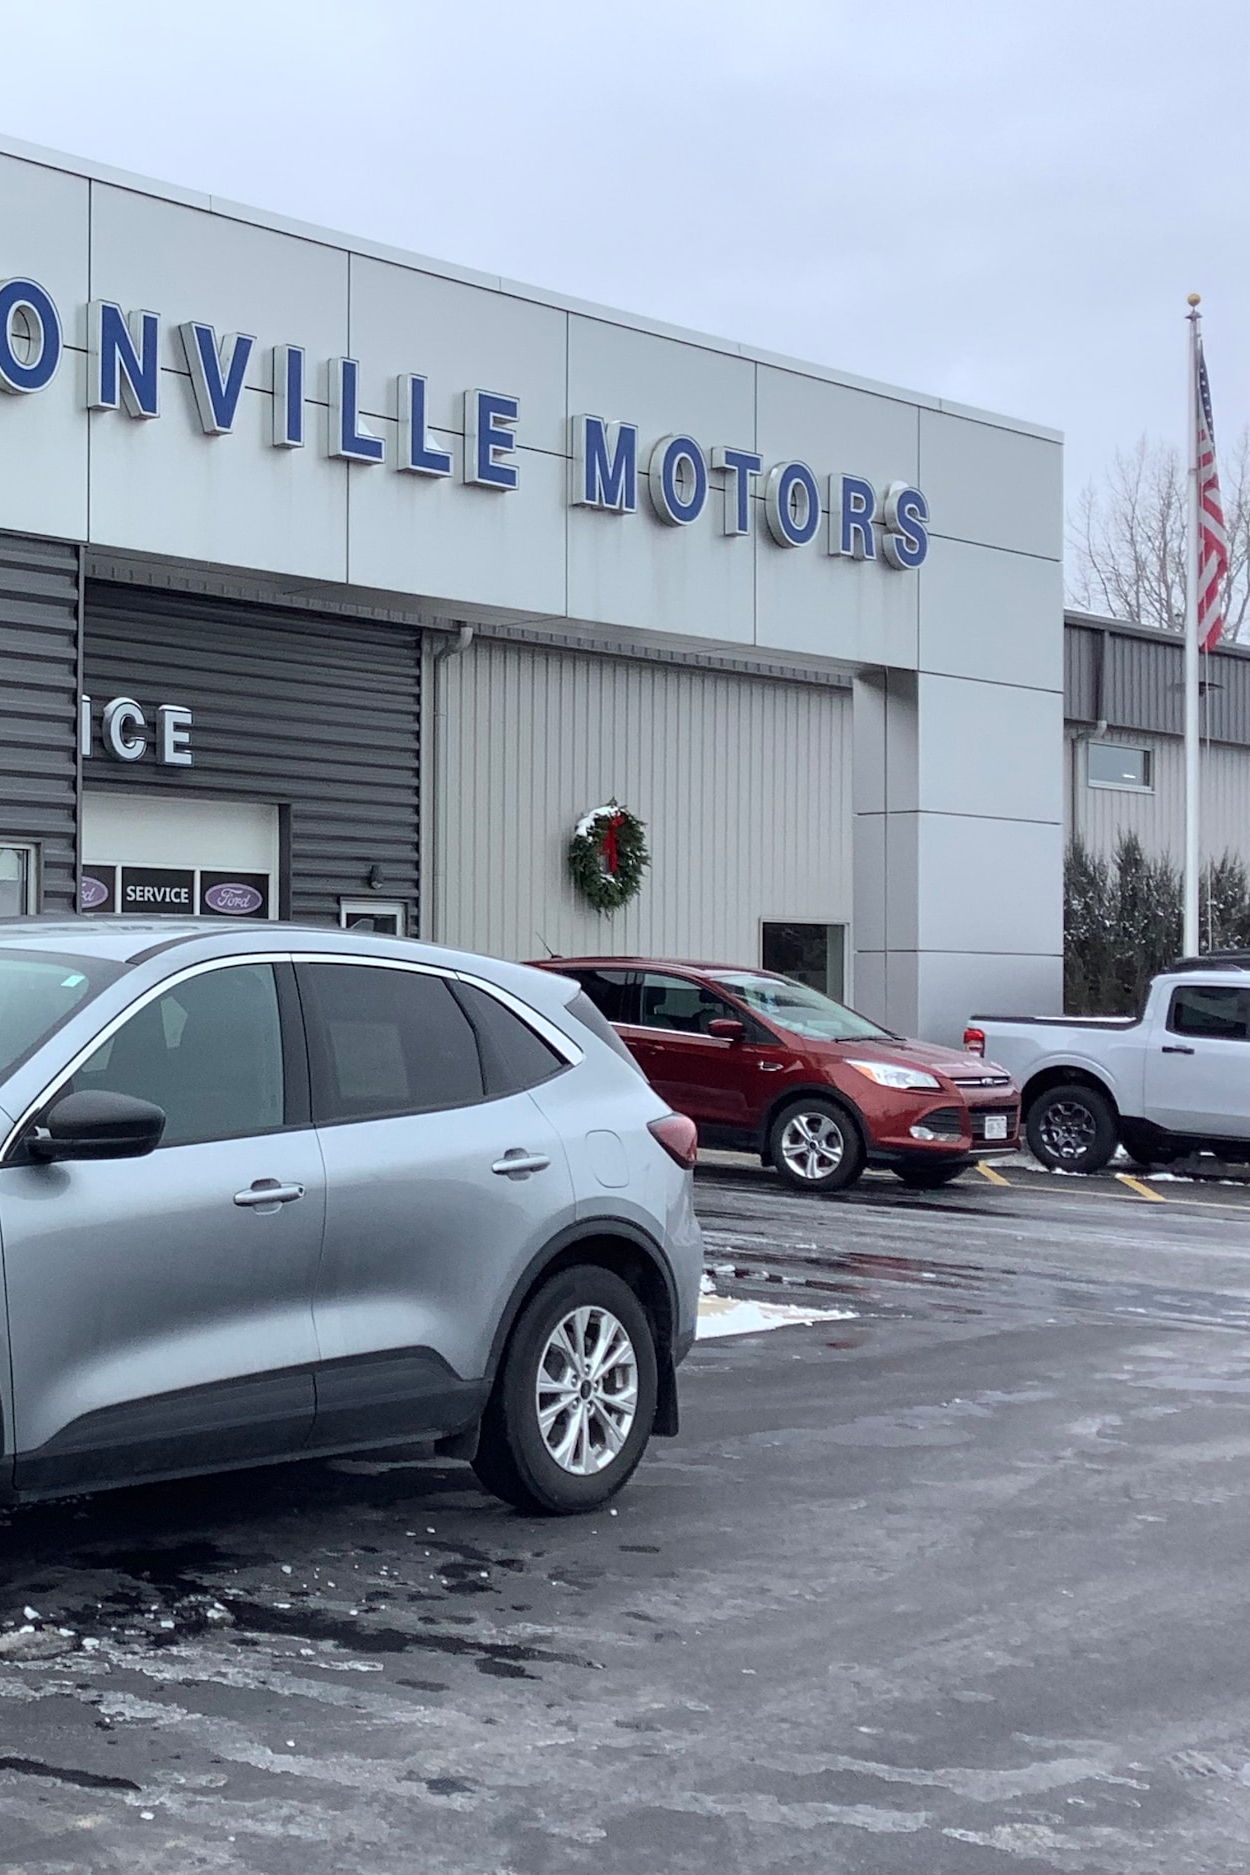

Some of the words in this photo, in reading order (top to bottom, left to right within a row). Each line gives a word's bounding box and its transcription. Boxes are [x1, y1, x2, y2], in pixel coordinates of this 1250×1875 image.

[571, 413, 932, 571] MOTORS
[126, 885, 189, 903] SERVICE
[217, 888, 251, 908] Ford
